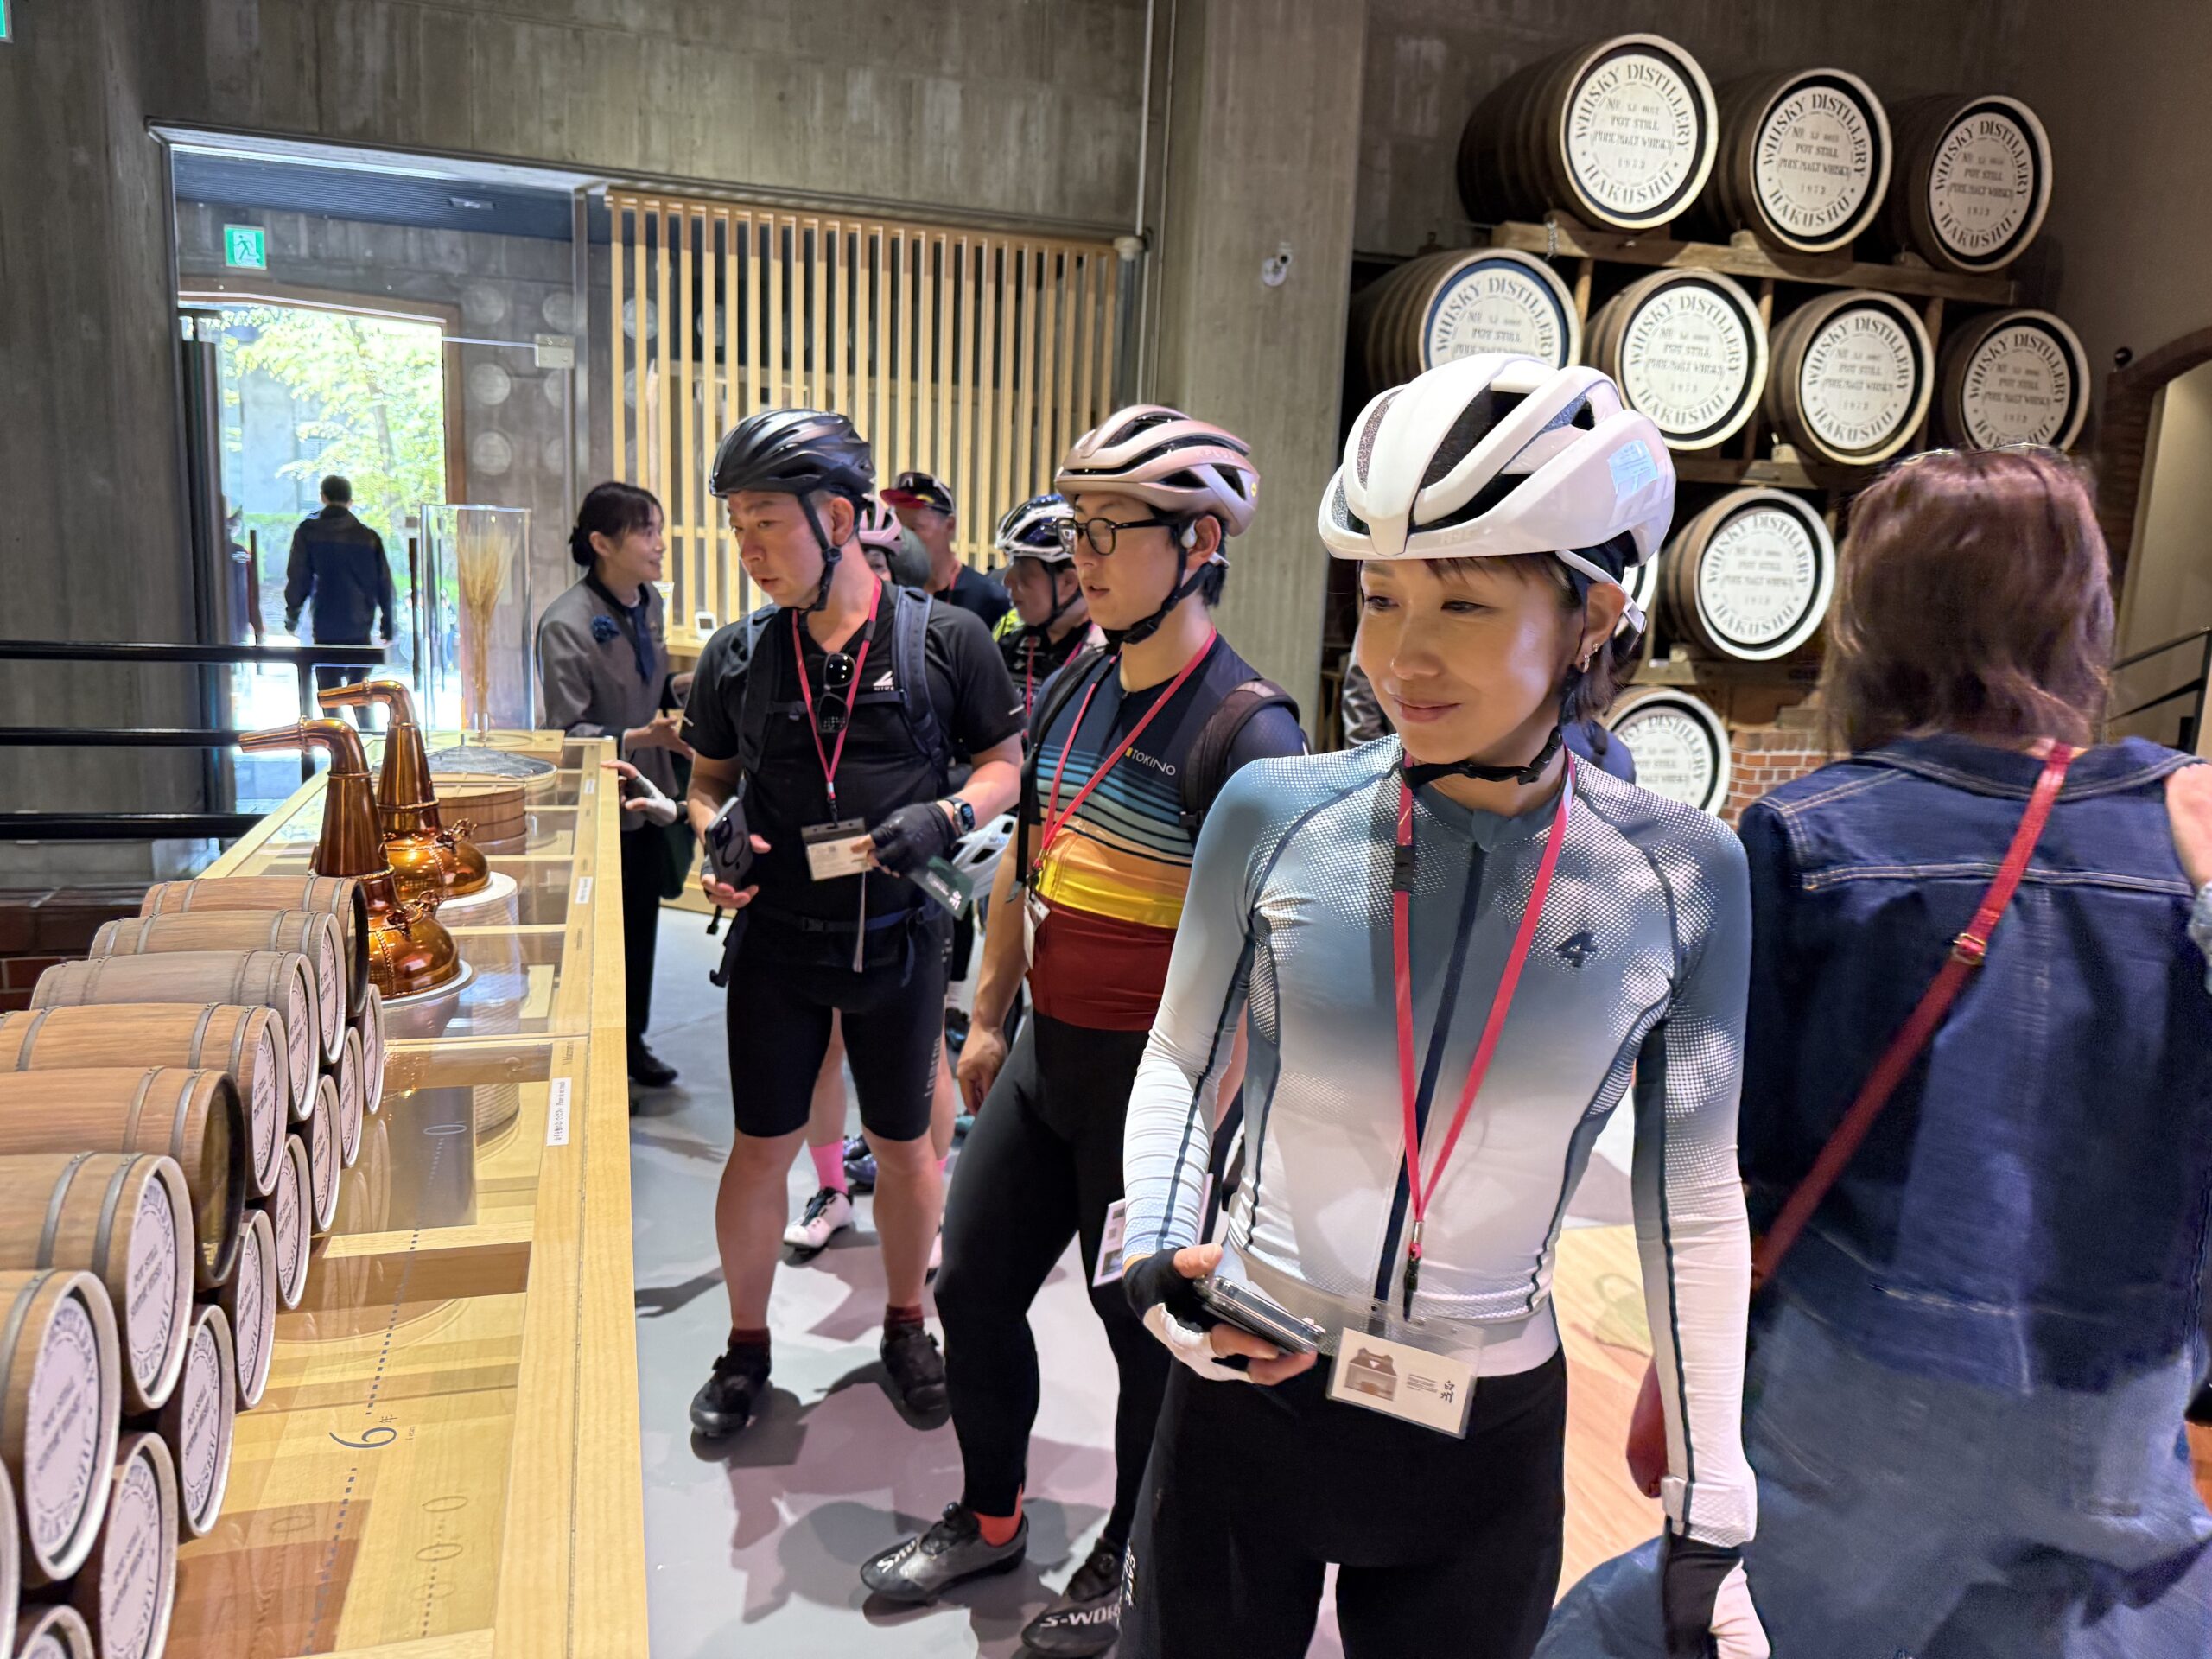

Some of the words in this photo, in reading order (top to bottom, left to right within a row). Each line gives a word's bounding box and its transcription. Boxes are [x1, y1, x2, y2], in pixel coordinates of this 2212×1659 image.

[1576, 67, 1619, 138] WHISKY
[1627, 64, 1689, 150] DISTILLERY
[1763, 97, 1806, 165] WHISKY
[1812, 93, 1866, 177] DISTILLERY
[1585, 164, 1674, 204] HAKUSHU
[1936, 124, 1974, 190] WHISKY
[1980, 120, 2028, 198] DISTILLERY
[1769, 189, 1850, 227] HAKUSHU
[1940, 213, 2012, 248] HAKUSHU
[1437, 281, 1481, 353] WHISKY
[1489, 276, 1554, 363] DISTILLERY
[1630, 296, 1673, 365] WHISKY
[1680, 295, 1742, 377] DISTILLERY
[1808, 321, 1848, 385] WHISKY
[1855, 316, 1910, 392] DISTILLERY
[1968, 336, 2008, 399] WHISKY
[2014, 333, 2066, 406] DISTILLERY
[1638, 389, 1726, 426] HAKUSHU
[1815, 408, 1893, 442] HAKUSHU
